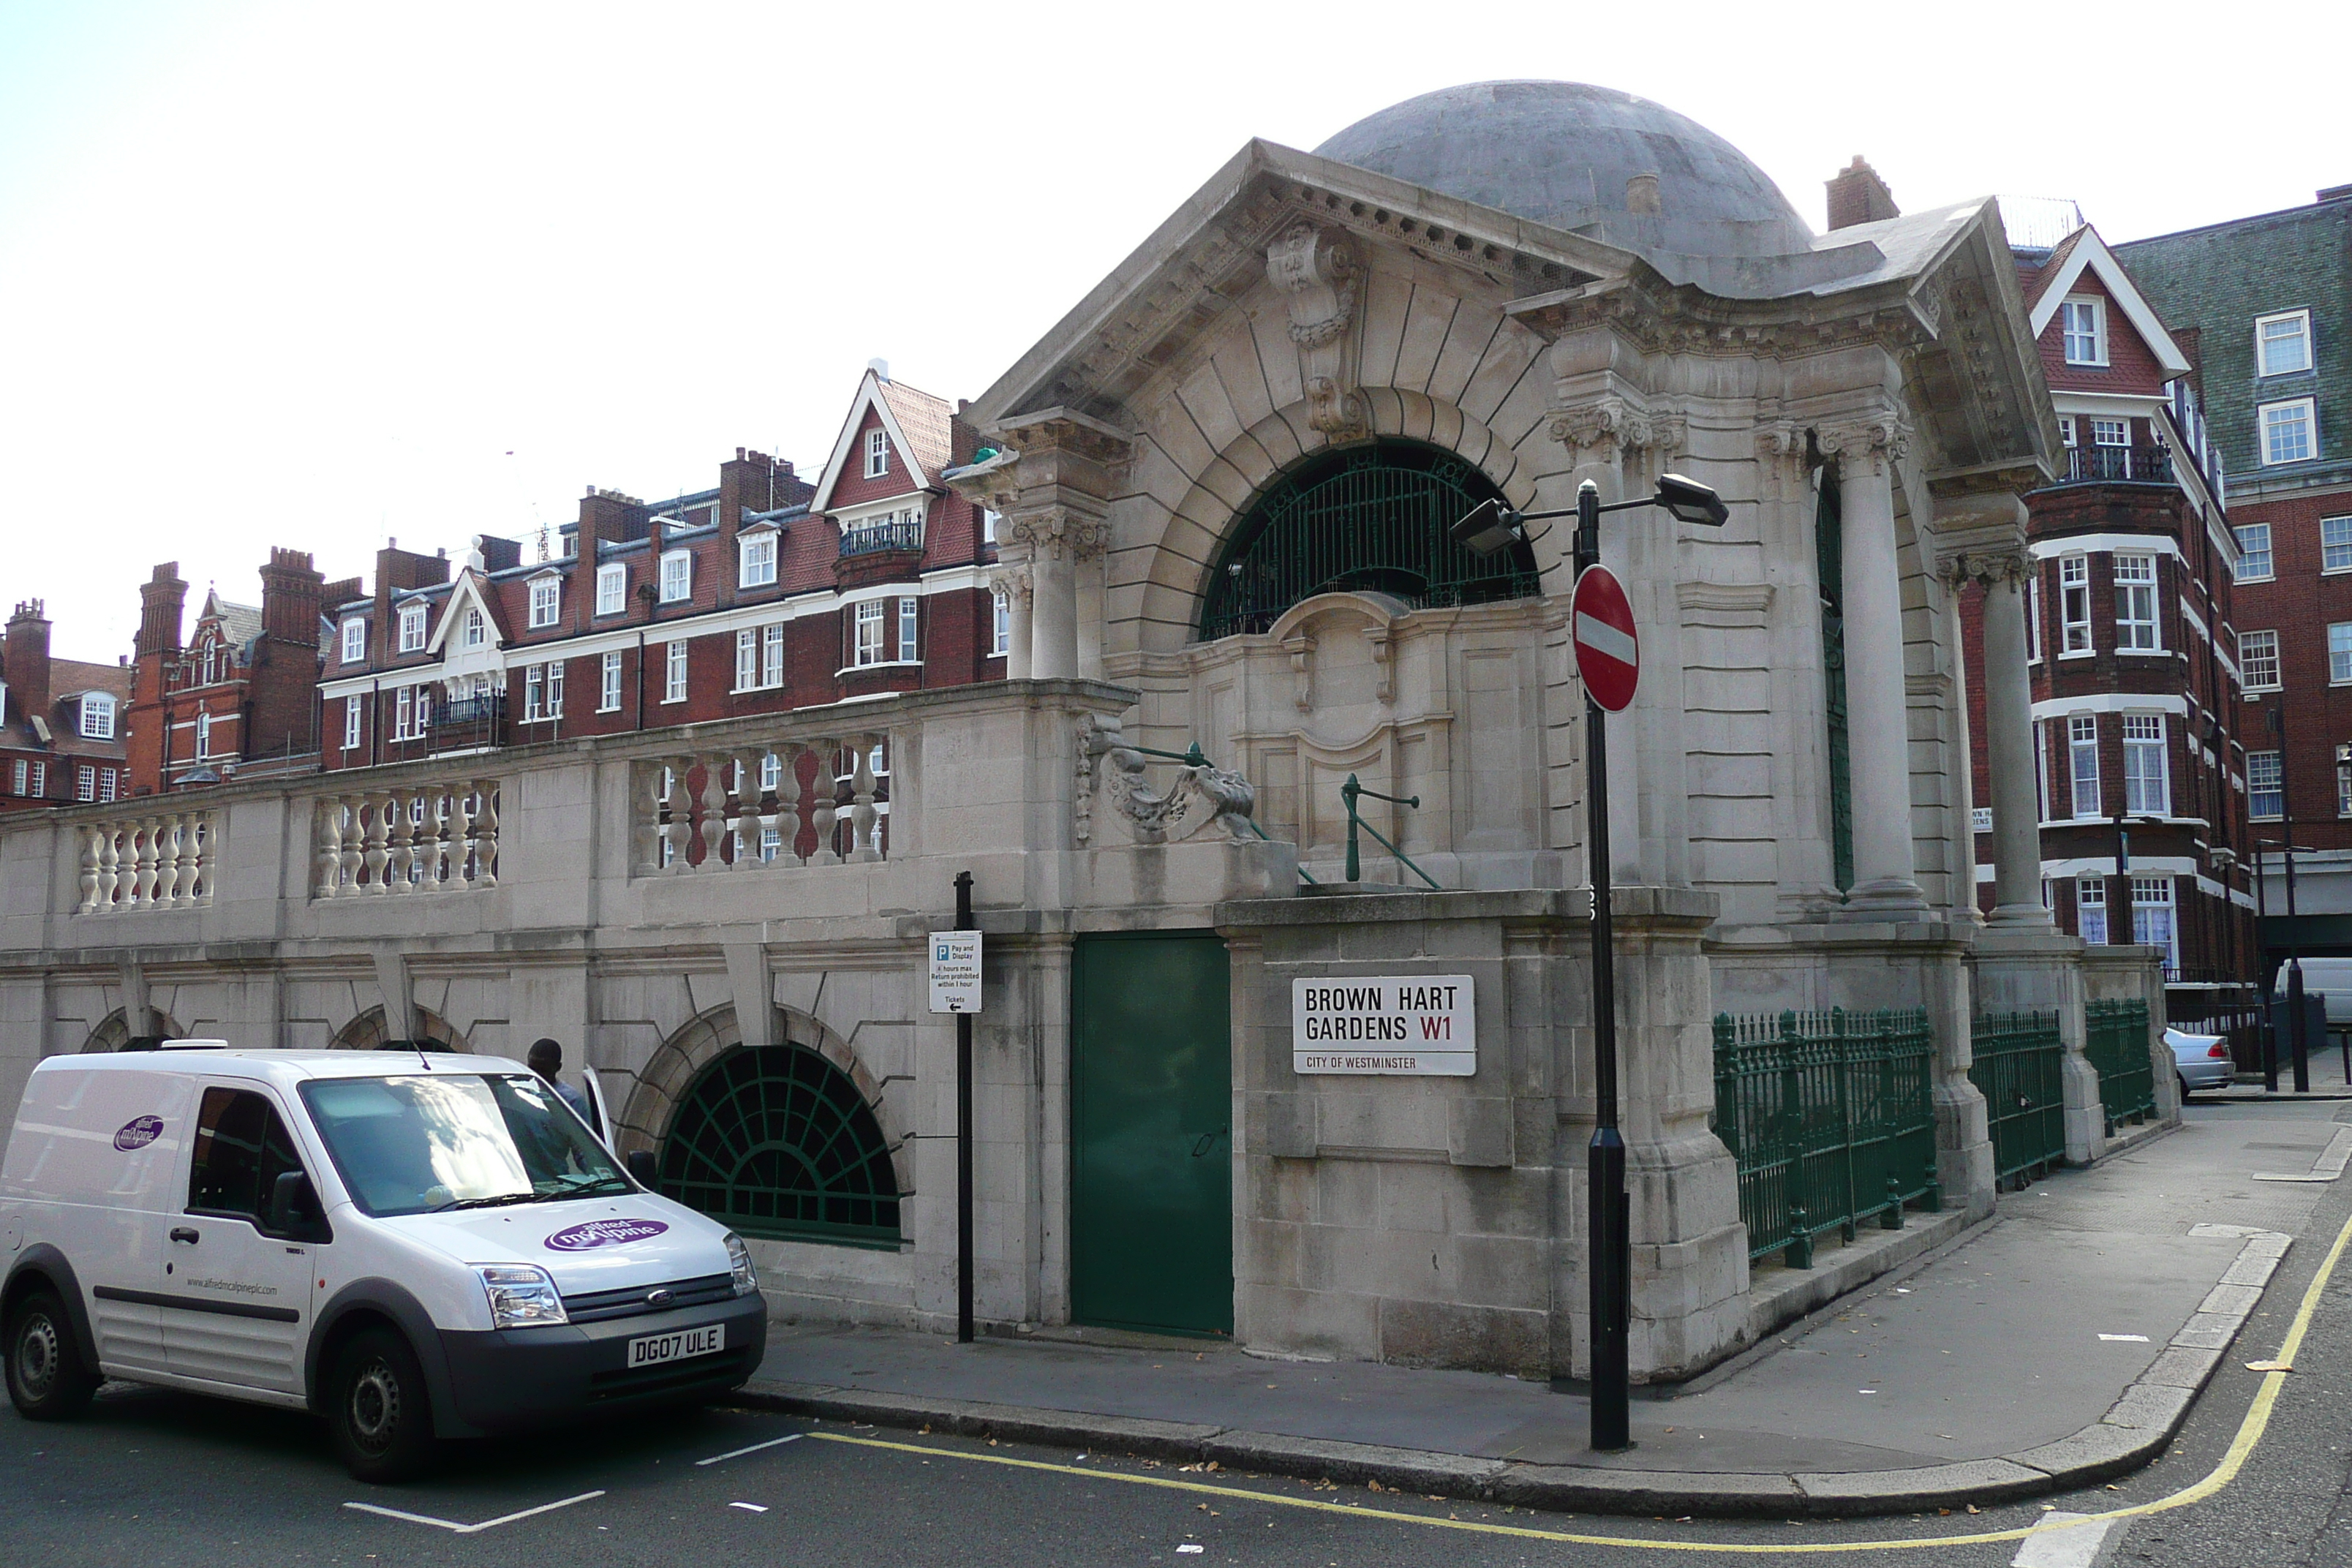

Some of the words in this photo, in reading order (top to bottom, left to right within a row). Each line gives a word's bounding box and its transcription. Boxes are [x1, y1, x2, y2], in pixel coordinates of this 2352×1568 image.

[939, 946, 946, 960] P
[951, 972, 979, 981] prohibited
[1305, 987, 1382, 1011] BROWN
[1399, 986, 1458, 1011] HART
[1306, 1017, 1407, 1040] GARDENS
[1420, 1016, 1450, 1040] W1
[1306, 1056, 1327, 1068] CITY
[1331, 1057, 1343, 1068] OF
[1346, 1057, 1416, 1068] WESTMINSTER
[582, 1220, 632, 1231] alfred
[186, 1277, 277, 1295] www.alfredmcalpineplc.com
[635, 1335, 682, 1362] DG07
[686, 1329, 717, 1354] ULE
